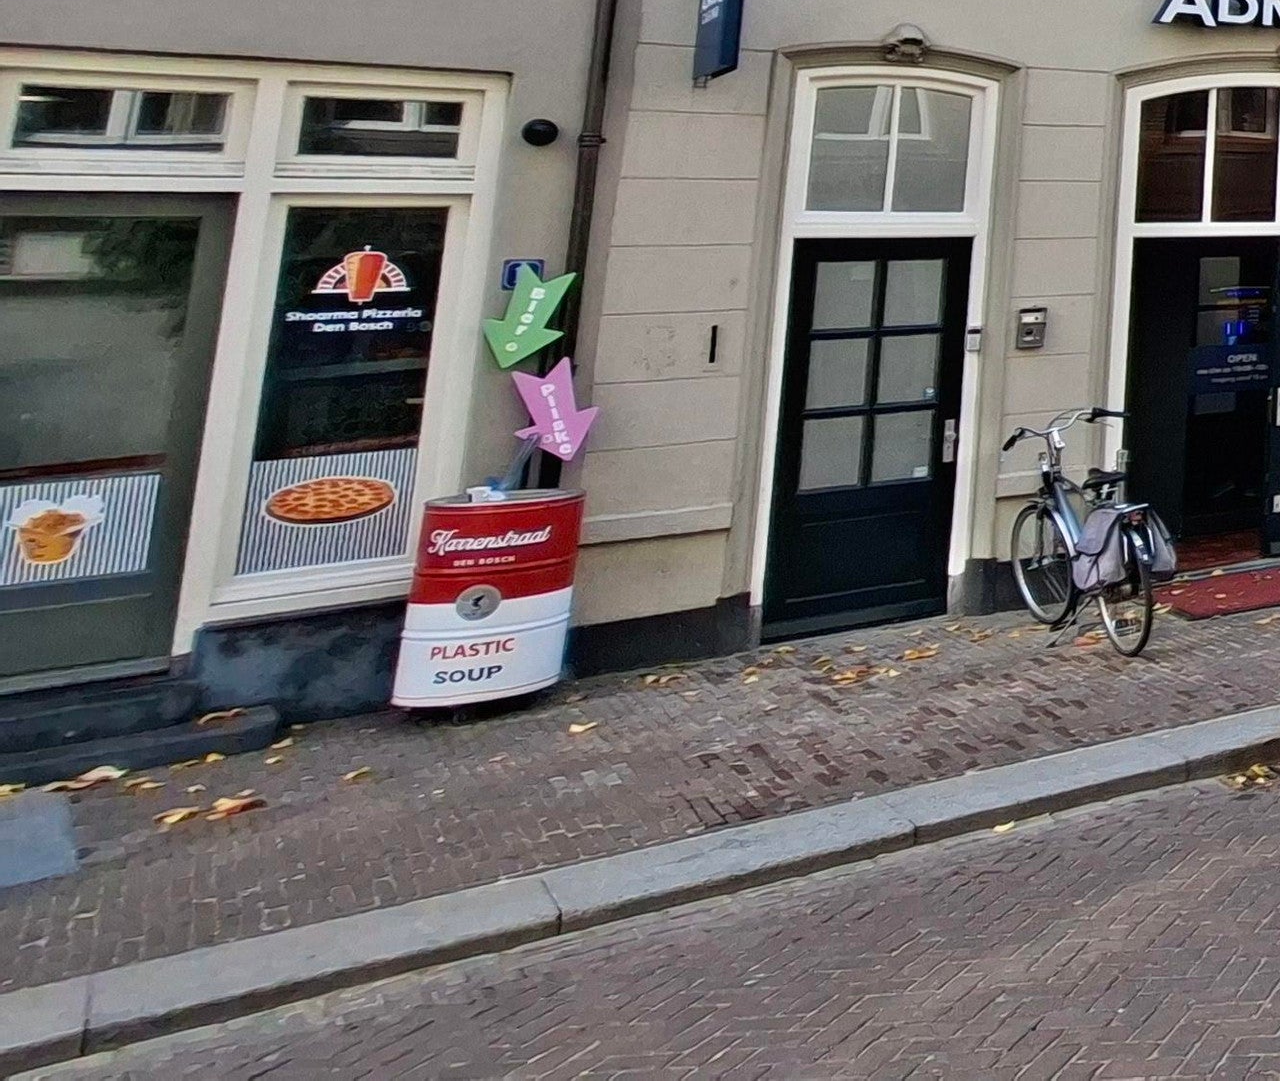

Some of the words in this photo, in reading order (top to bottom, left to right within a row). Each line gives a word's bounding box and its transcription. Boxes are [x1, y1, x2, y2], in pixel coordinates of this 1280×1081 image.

[312, 322, 345, 332] Den
[348, 321, 394, 331] Bosch
[430, 637, 515, 660] PLASTIC
[433, 665, 503, 684] SOUP
